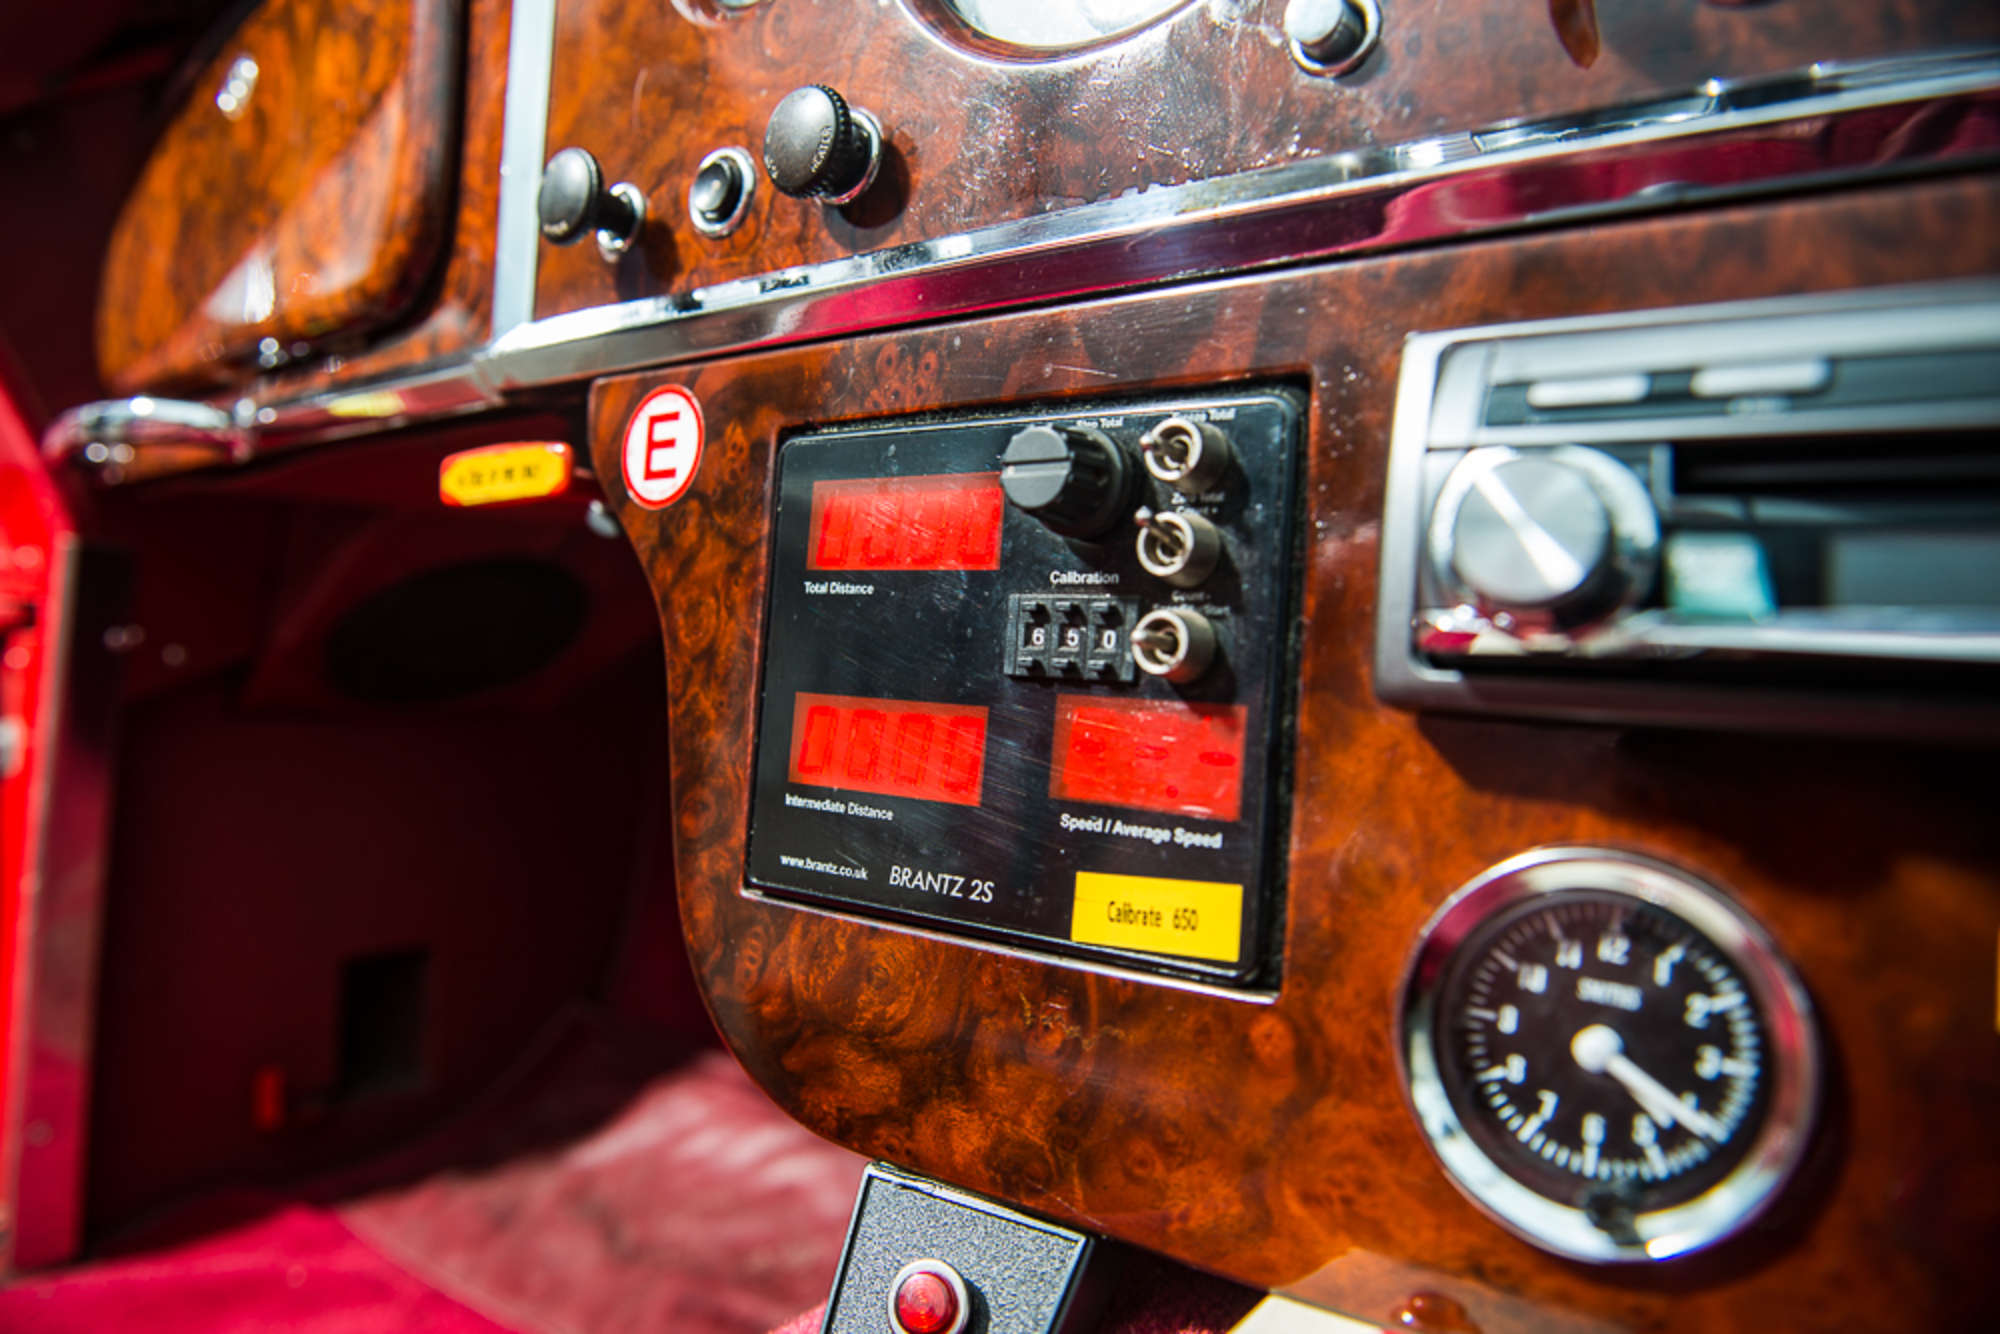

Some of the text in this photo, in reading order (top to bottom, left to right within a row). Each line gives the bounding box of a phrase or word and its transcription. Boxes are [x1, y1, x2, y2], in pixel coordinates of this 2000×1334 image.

[644, 412, 680, 480] E
[804, 581, 875, 594] Total Distance
[1050, 571, 1119, 584] Calibration
[1032, 628, 1116, 648] 6 5 0
[784, 793, 894, 821] Intermediate Distance
[1060, 813, 1223, 849] Speed / Average Speed
[779, 855, 869, 880] www.brantz.co.uk
[889, 865, 995, 903] BRANTZ 2S
[1107, 900, 1198, 931] Calibrate 650
